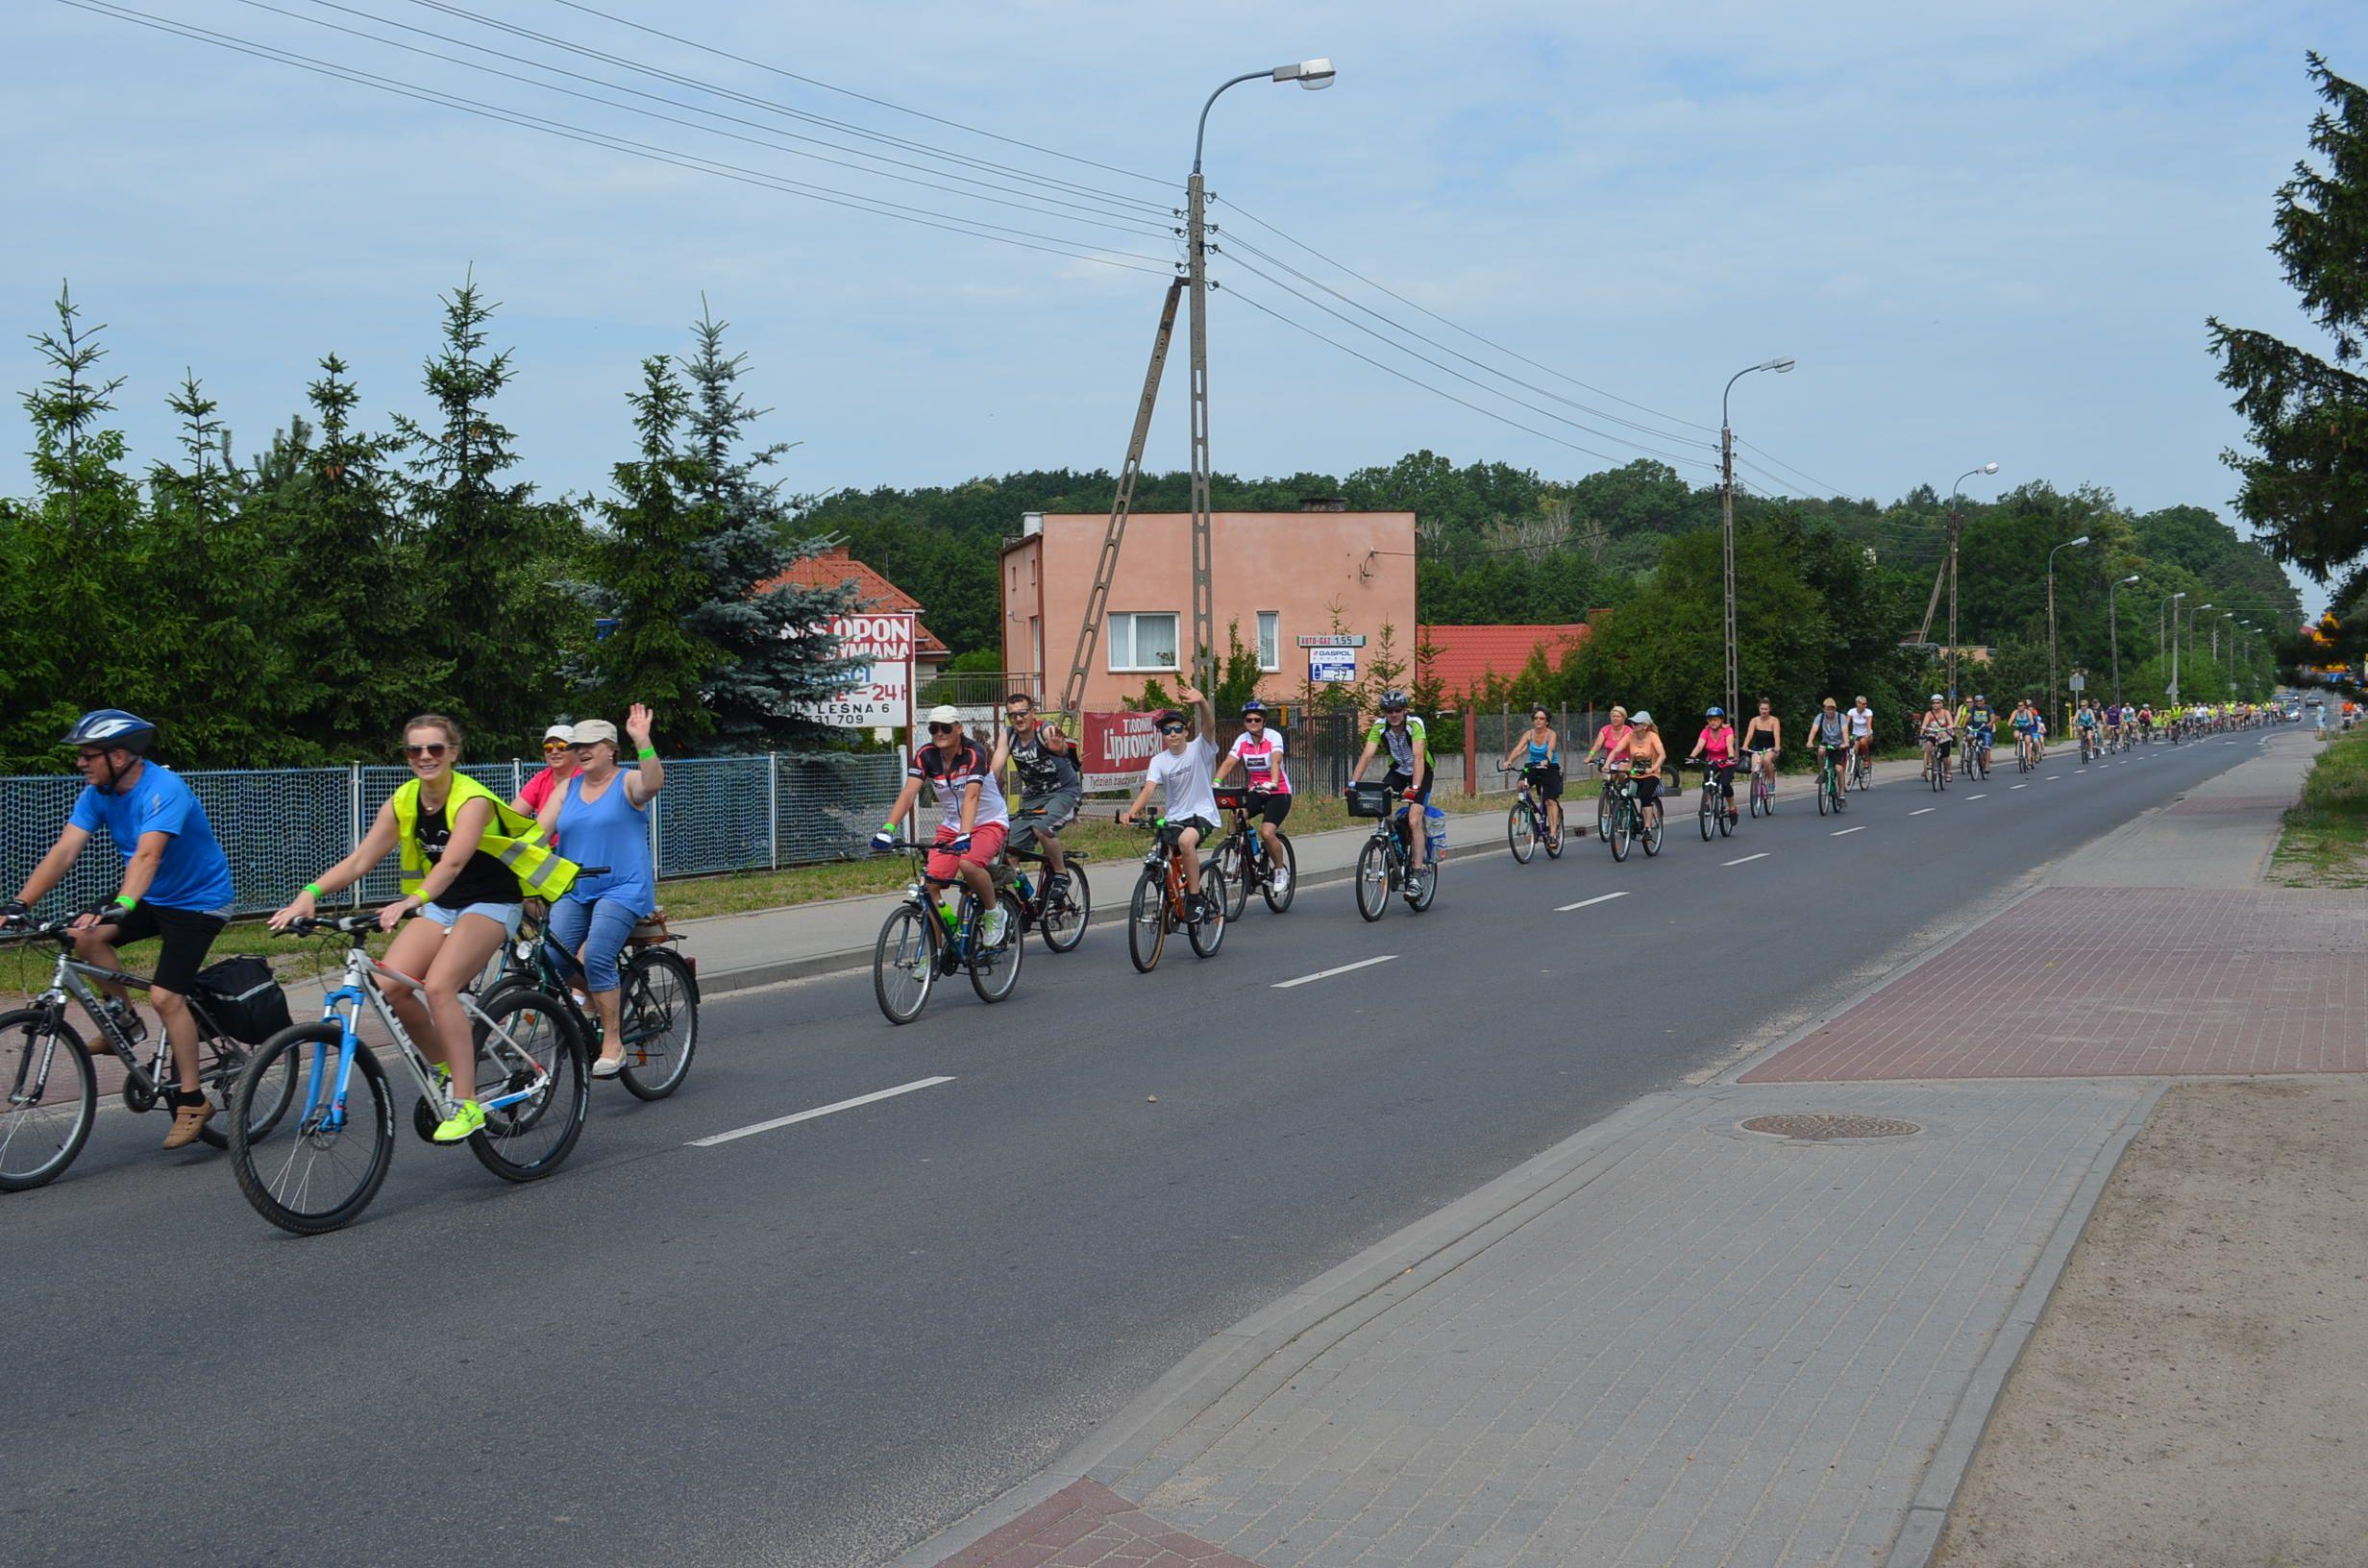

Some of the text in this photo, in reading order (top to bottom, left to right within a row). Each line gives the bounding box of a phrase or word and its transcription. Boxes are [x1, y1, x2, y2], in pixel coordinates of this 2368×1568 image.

[834, 618, 910, 642] OPON
[872, 684, 897, 701] 24
[817, 702, 890, 714] LEŚNA 6
[838, 715, 864, 724] 709
